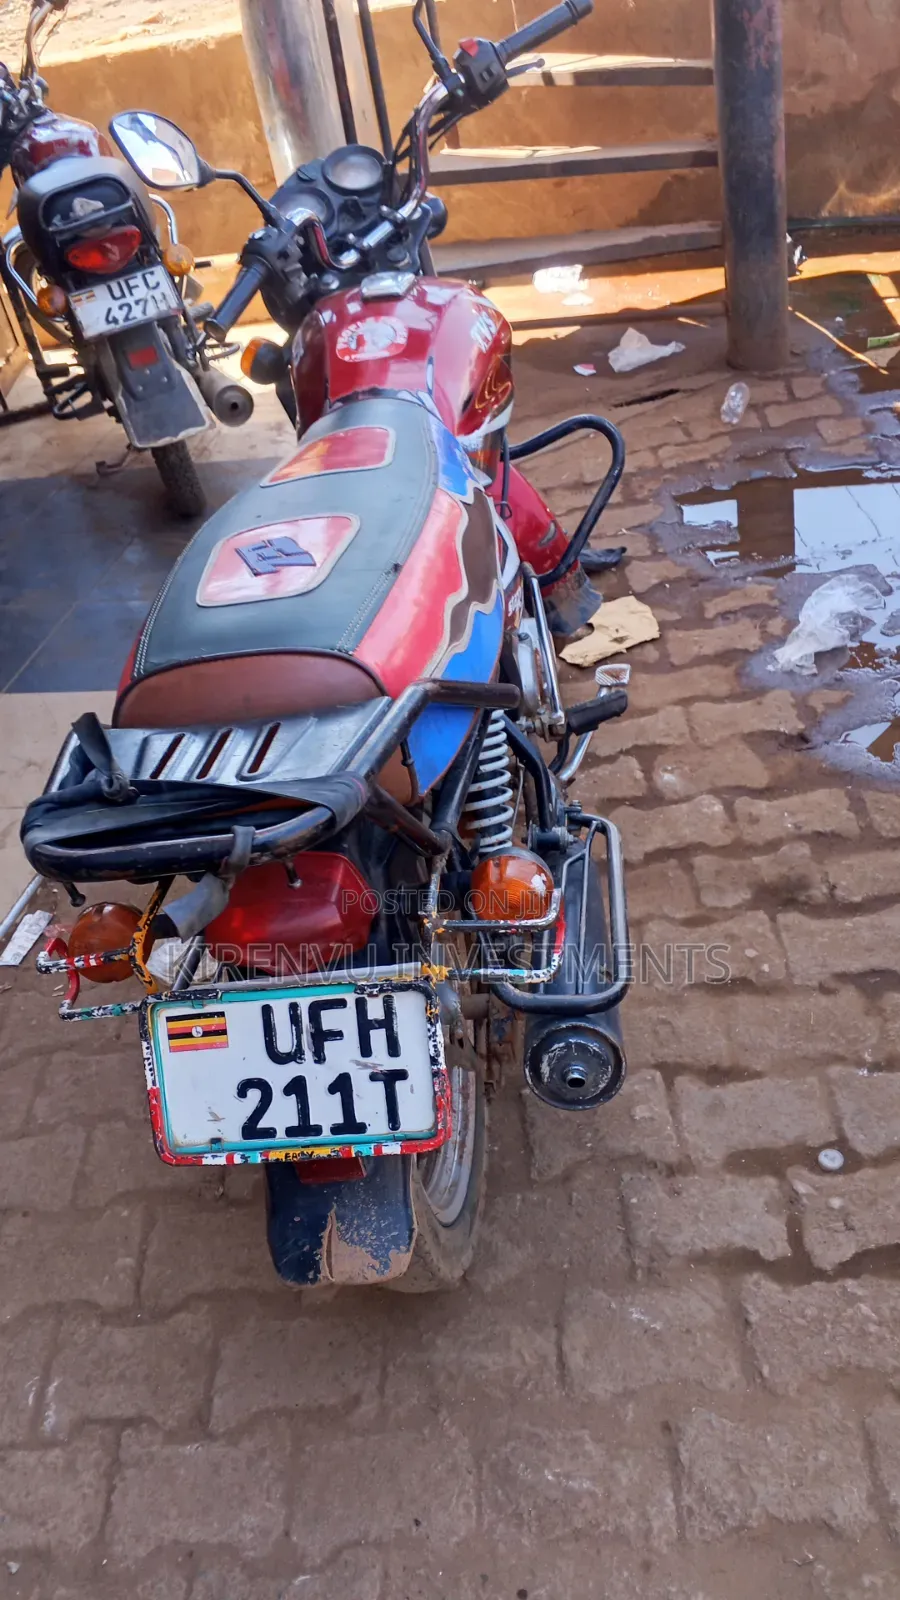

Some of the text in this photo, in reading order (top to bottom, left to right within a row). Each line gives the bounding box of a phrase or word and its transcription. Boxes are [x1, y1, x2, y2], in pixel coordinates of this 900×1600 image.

[107, 270, 160, 301] UFC
[261, 994, 402, 1066] UFH
[236, 1068, 409, 1140] 211T
